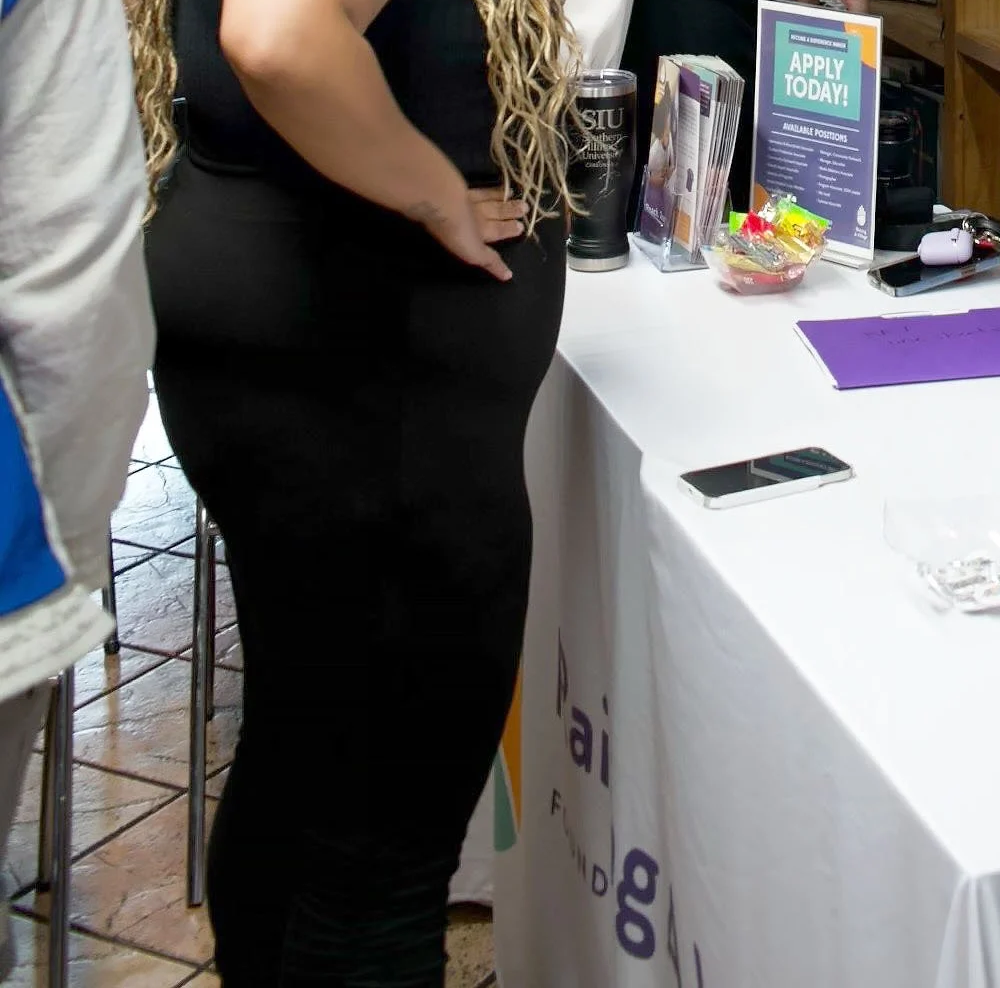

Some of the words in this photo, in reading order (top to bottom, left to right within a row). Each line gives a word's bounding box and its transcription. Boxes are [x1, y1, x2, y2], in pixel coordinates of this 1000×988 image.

[789, 51, 845, 81] APPLY
[784, 73, 848, 108] TODAY!
[581, 108, 624, 131] SIU
[782, 122, 813, 137] AVAILABLE
[814, 128, 848, 144] POSITIONS
